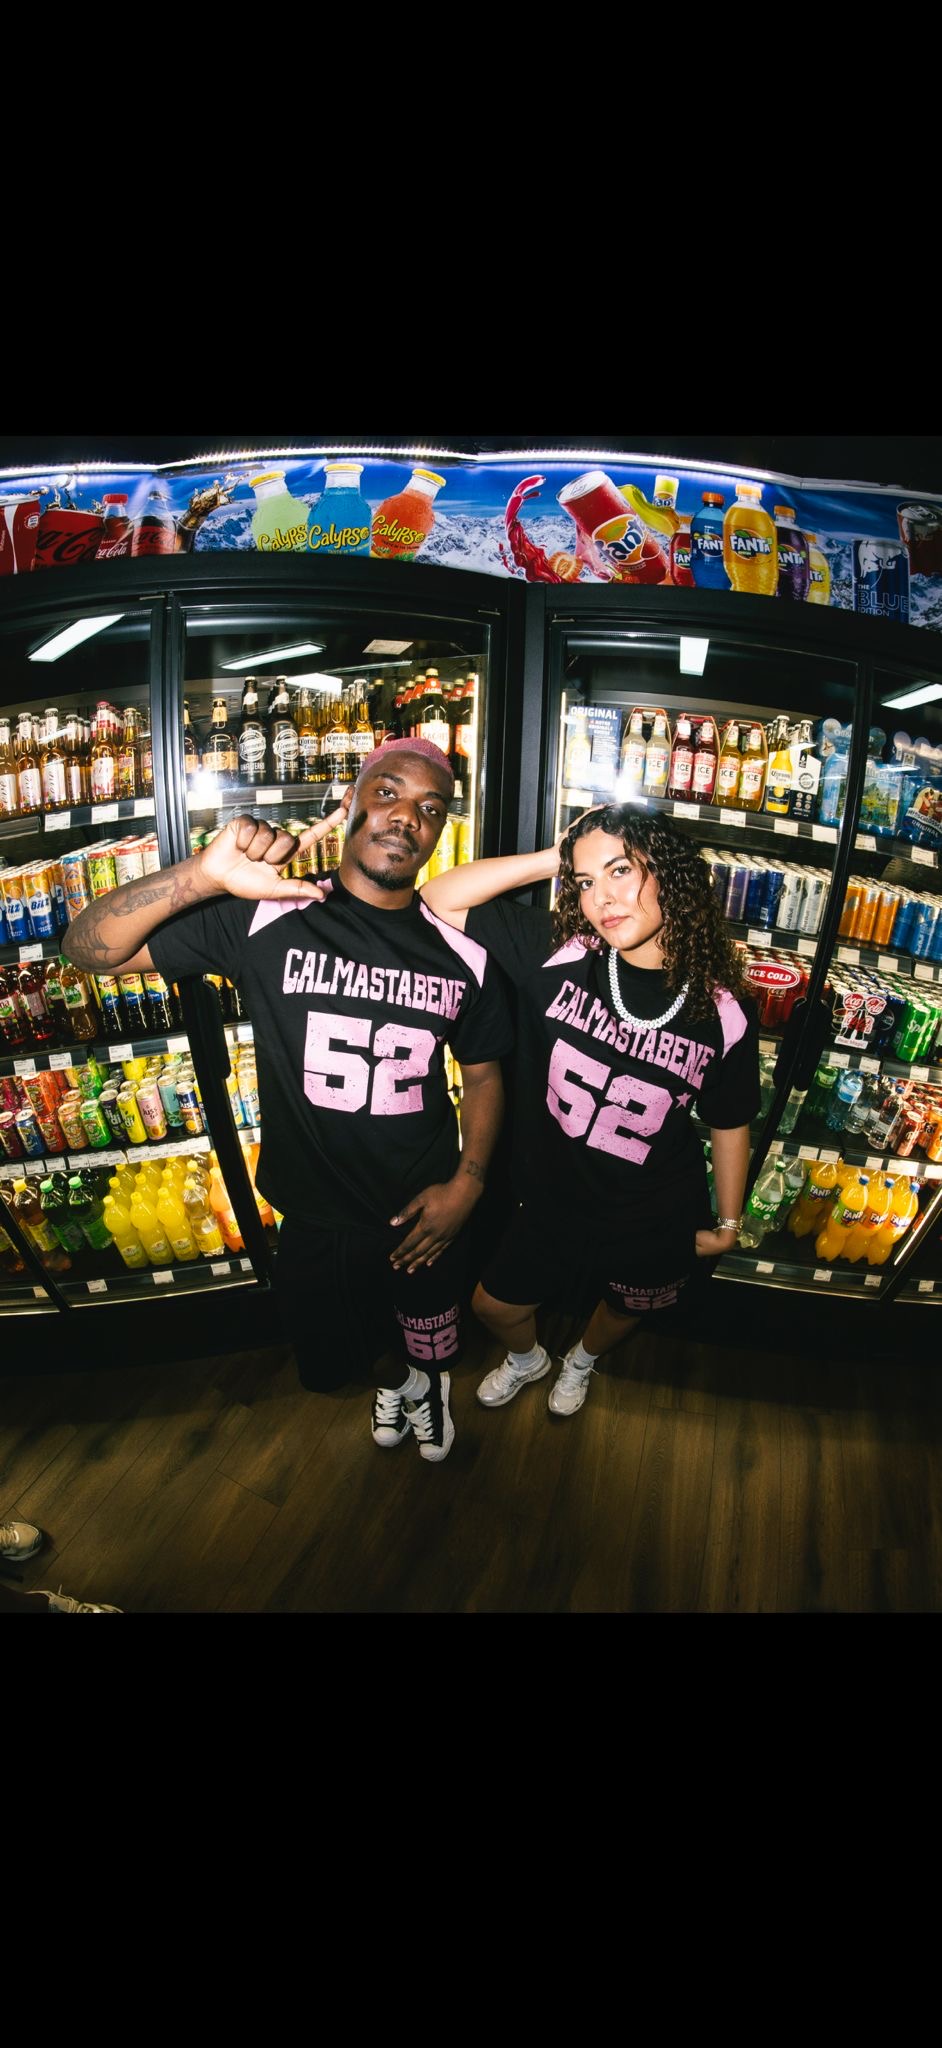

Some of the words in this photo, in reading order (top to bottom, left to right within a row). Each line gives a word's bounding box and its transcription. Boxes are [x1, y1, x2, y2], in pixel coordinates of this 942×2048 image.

[257, 524, 308, 551] Calyps
[309, 523, 370, 550] Calypso
[371, 515, 424, 545] Calypso
[698, 537, 724, 550] FANT
[730, 535, 771, 553] FANTA
[673, 551, 691, 563] FAN
[777, 550, 805, 565] ANTA
[858, 590, 909, 613] BLUE
[857, 606, 890, 617] EDITION
[570, 706, 618, 720] ORIGINAL
[677, 763, 690, 772] ICE
[697, 766, 710, 775] ICE
[720, 768, 734, 778] ICE
[750, 969, 766, 977] ICE
[767, 971, 792, 982] COLD
[282, 948, 467, 1021] CALMASTABENE
[545, 979, 716, 1090] CALMASTABENE
[303, 1010, 437, 1116] 52
[546, 1038, 674, 1166] 52
[810, 1185, 832, 1196] FANT
[751, 1195, 780, 1212] Sprit
[843, 1208, 864, 1220] FANT
[624, 1289, 678, 1311] 52
[403, 1324, 459, 1361] 52
